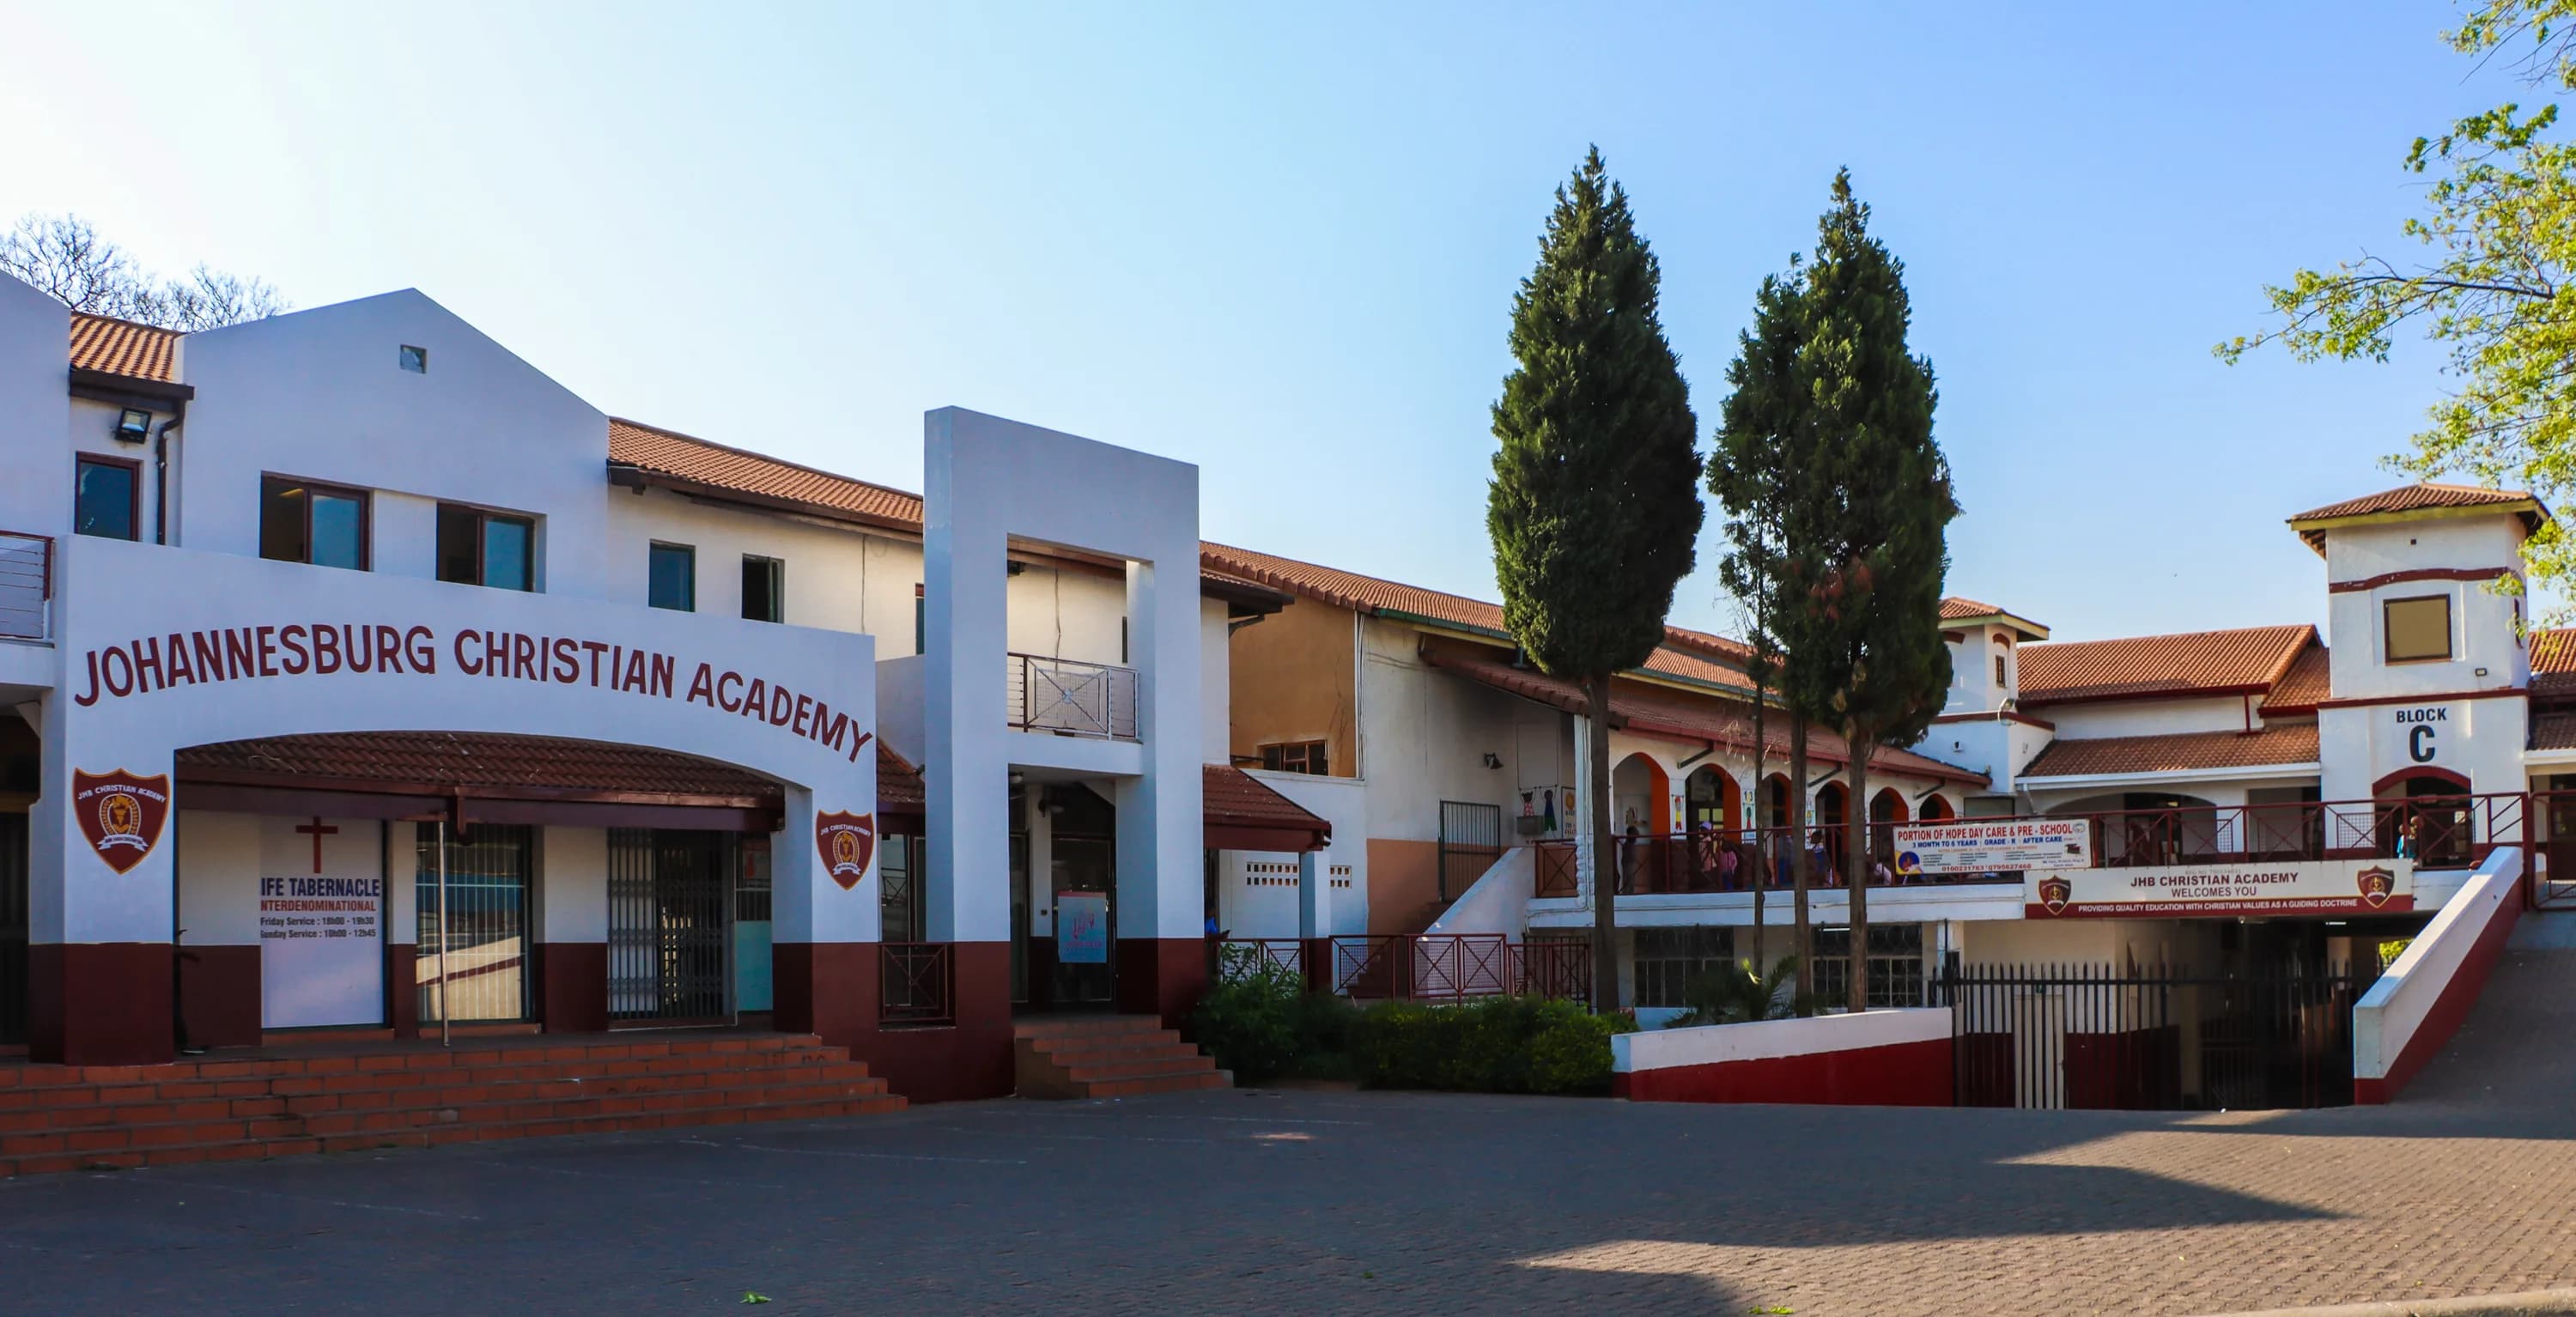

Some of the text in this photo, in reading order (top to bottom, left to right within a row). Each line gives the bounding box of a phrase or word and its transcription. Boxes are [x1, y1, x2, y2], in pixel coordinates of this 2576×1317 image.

[75, 624, 873, 763] JOHANNESBURG CHRISTIAN ACADEMY
[2397, 707, 2447, 723] BLOCK
[2409, 725, 2435, 762] C
[94, 784, 137, 794] CHRISTIAN
[137, 788, 167, 804] ACADEMY
[1898, 830, 1931, 841] PORTION
[1934, 829, 1943, 840] OF
[1946, 828, 1967, 839] HOPE
[1969, 828, 1984, 838] DAY
[1986, 827, 2007, 838] CARE
[2009, 826, 2015, 836] &
[2018, 825, 2032, 836] PRE
[2039, 823, 2073, 835] SCHOOL
[261, 877, 380, 896] IFE TABERNACLE
[2131, 872, 2299, 887] JHB CHRISTIAN ACADEMY
[2171, 886, 2257, 898] WELCOMES YOU
[261, 900, 376, 911] NTERDENOMINATIONAL
[2078, 904, 2114, 913] PROVIDING
[2146, 903, 2184, 912] EDUCATION
[2204, 901, 2241, 910] CHRISTIAN
[2243, 901, 2269, 909] VALUES
[2288, 900, 2318, 908] GUIDING
[2320, 899, 2358, 907] DOCTRINE
[261, 917, 284, 927] Friday
